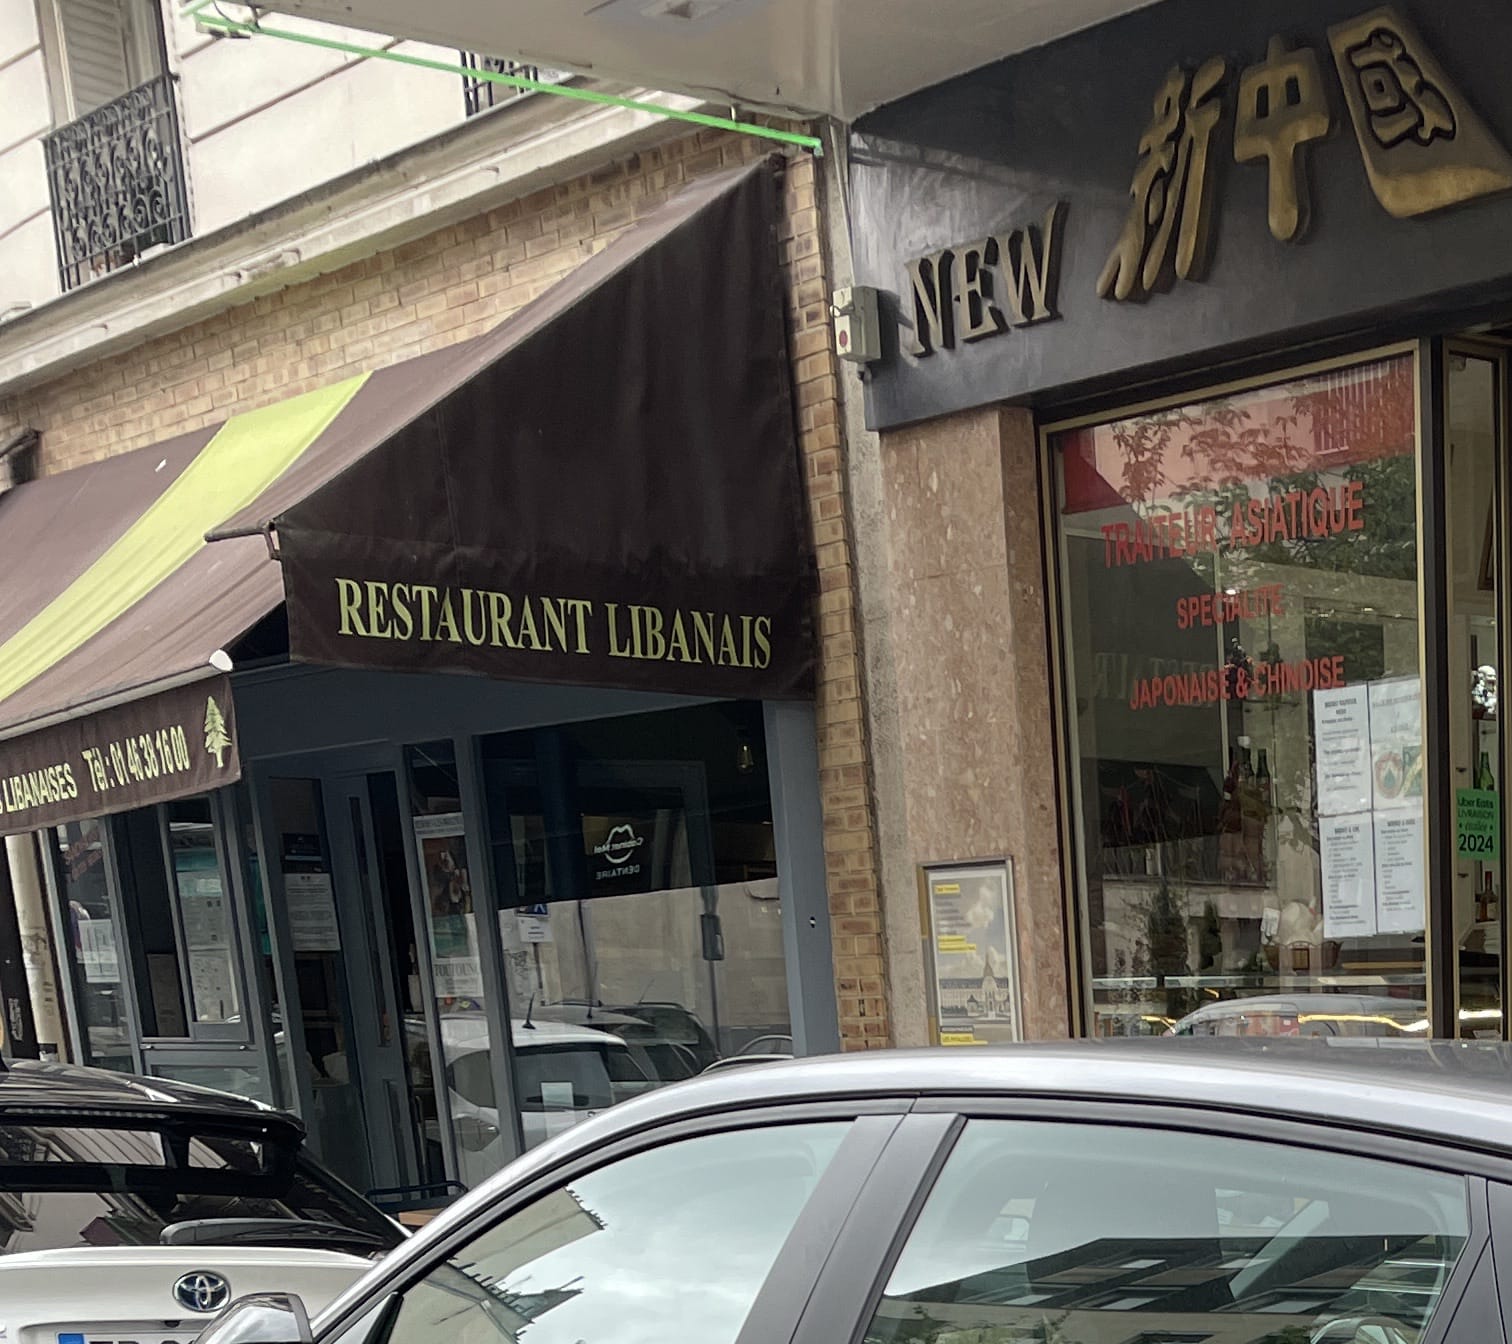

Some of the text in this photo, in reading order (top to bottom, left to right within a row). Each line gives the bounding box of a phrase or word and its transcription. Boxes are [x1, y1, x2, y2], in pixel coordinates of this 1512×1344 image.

[904, 198, 1069, 358] NEW
[1101, 481, 1366, 568] TRAITEUR ASIATIQUE
[335, 577, 773, 670] RESTAURANT LIBANAIS
[1129, 666, 1231, 711] JAPONAISE
[1235, 670, 1249, 698] &
[1253, 655, 1347, 697] CHINOISE
[2, 763, 79, 812] LIBANAISES
[109, 741, 130, 787] 01
[125, 737, 146, 783] 46
[139, 733, 160, 780] 38
[155, 728, 175, 775] 16
[170, 725, 191, 771] 00
[1458, 833, 1494, 853] 2024
